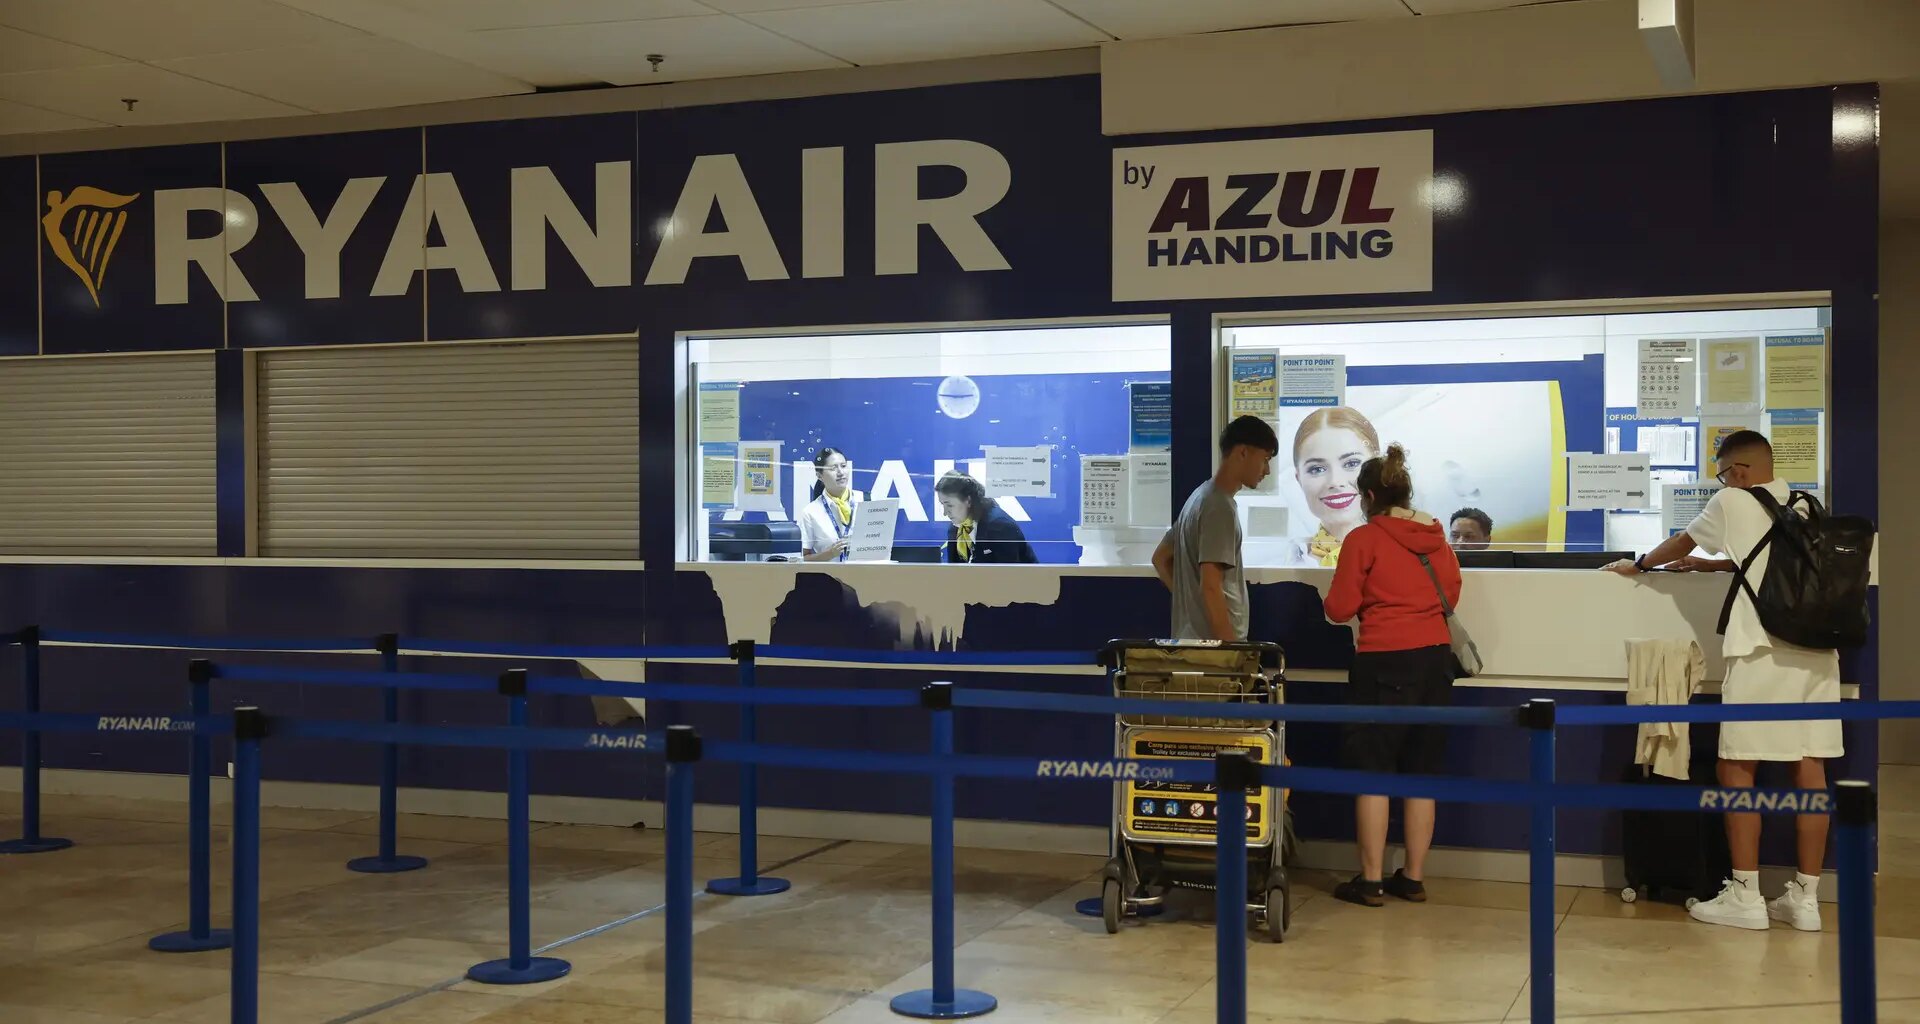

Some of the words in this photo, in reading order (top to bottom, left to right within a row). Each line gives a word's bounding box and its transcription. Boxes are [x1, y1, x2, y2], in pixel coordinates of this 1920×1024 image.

[1123, 160, 1156, 189] by
[1147, 167, 1395, 233] AZUL
[153, 139, 1013, 304] RYANAIR
[1147, 229, 1394, 267] HANDLING
